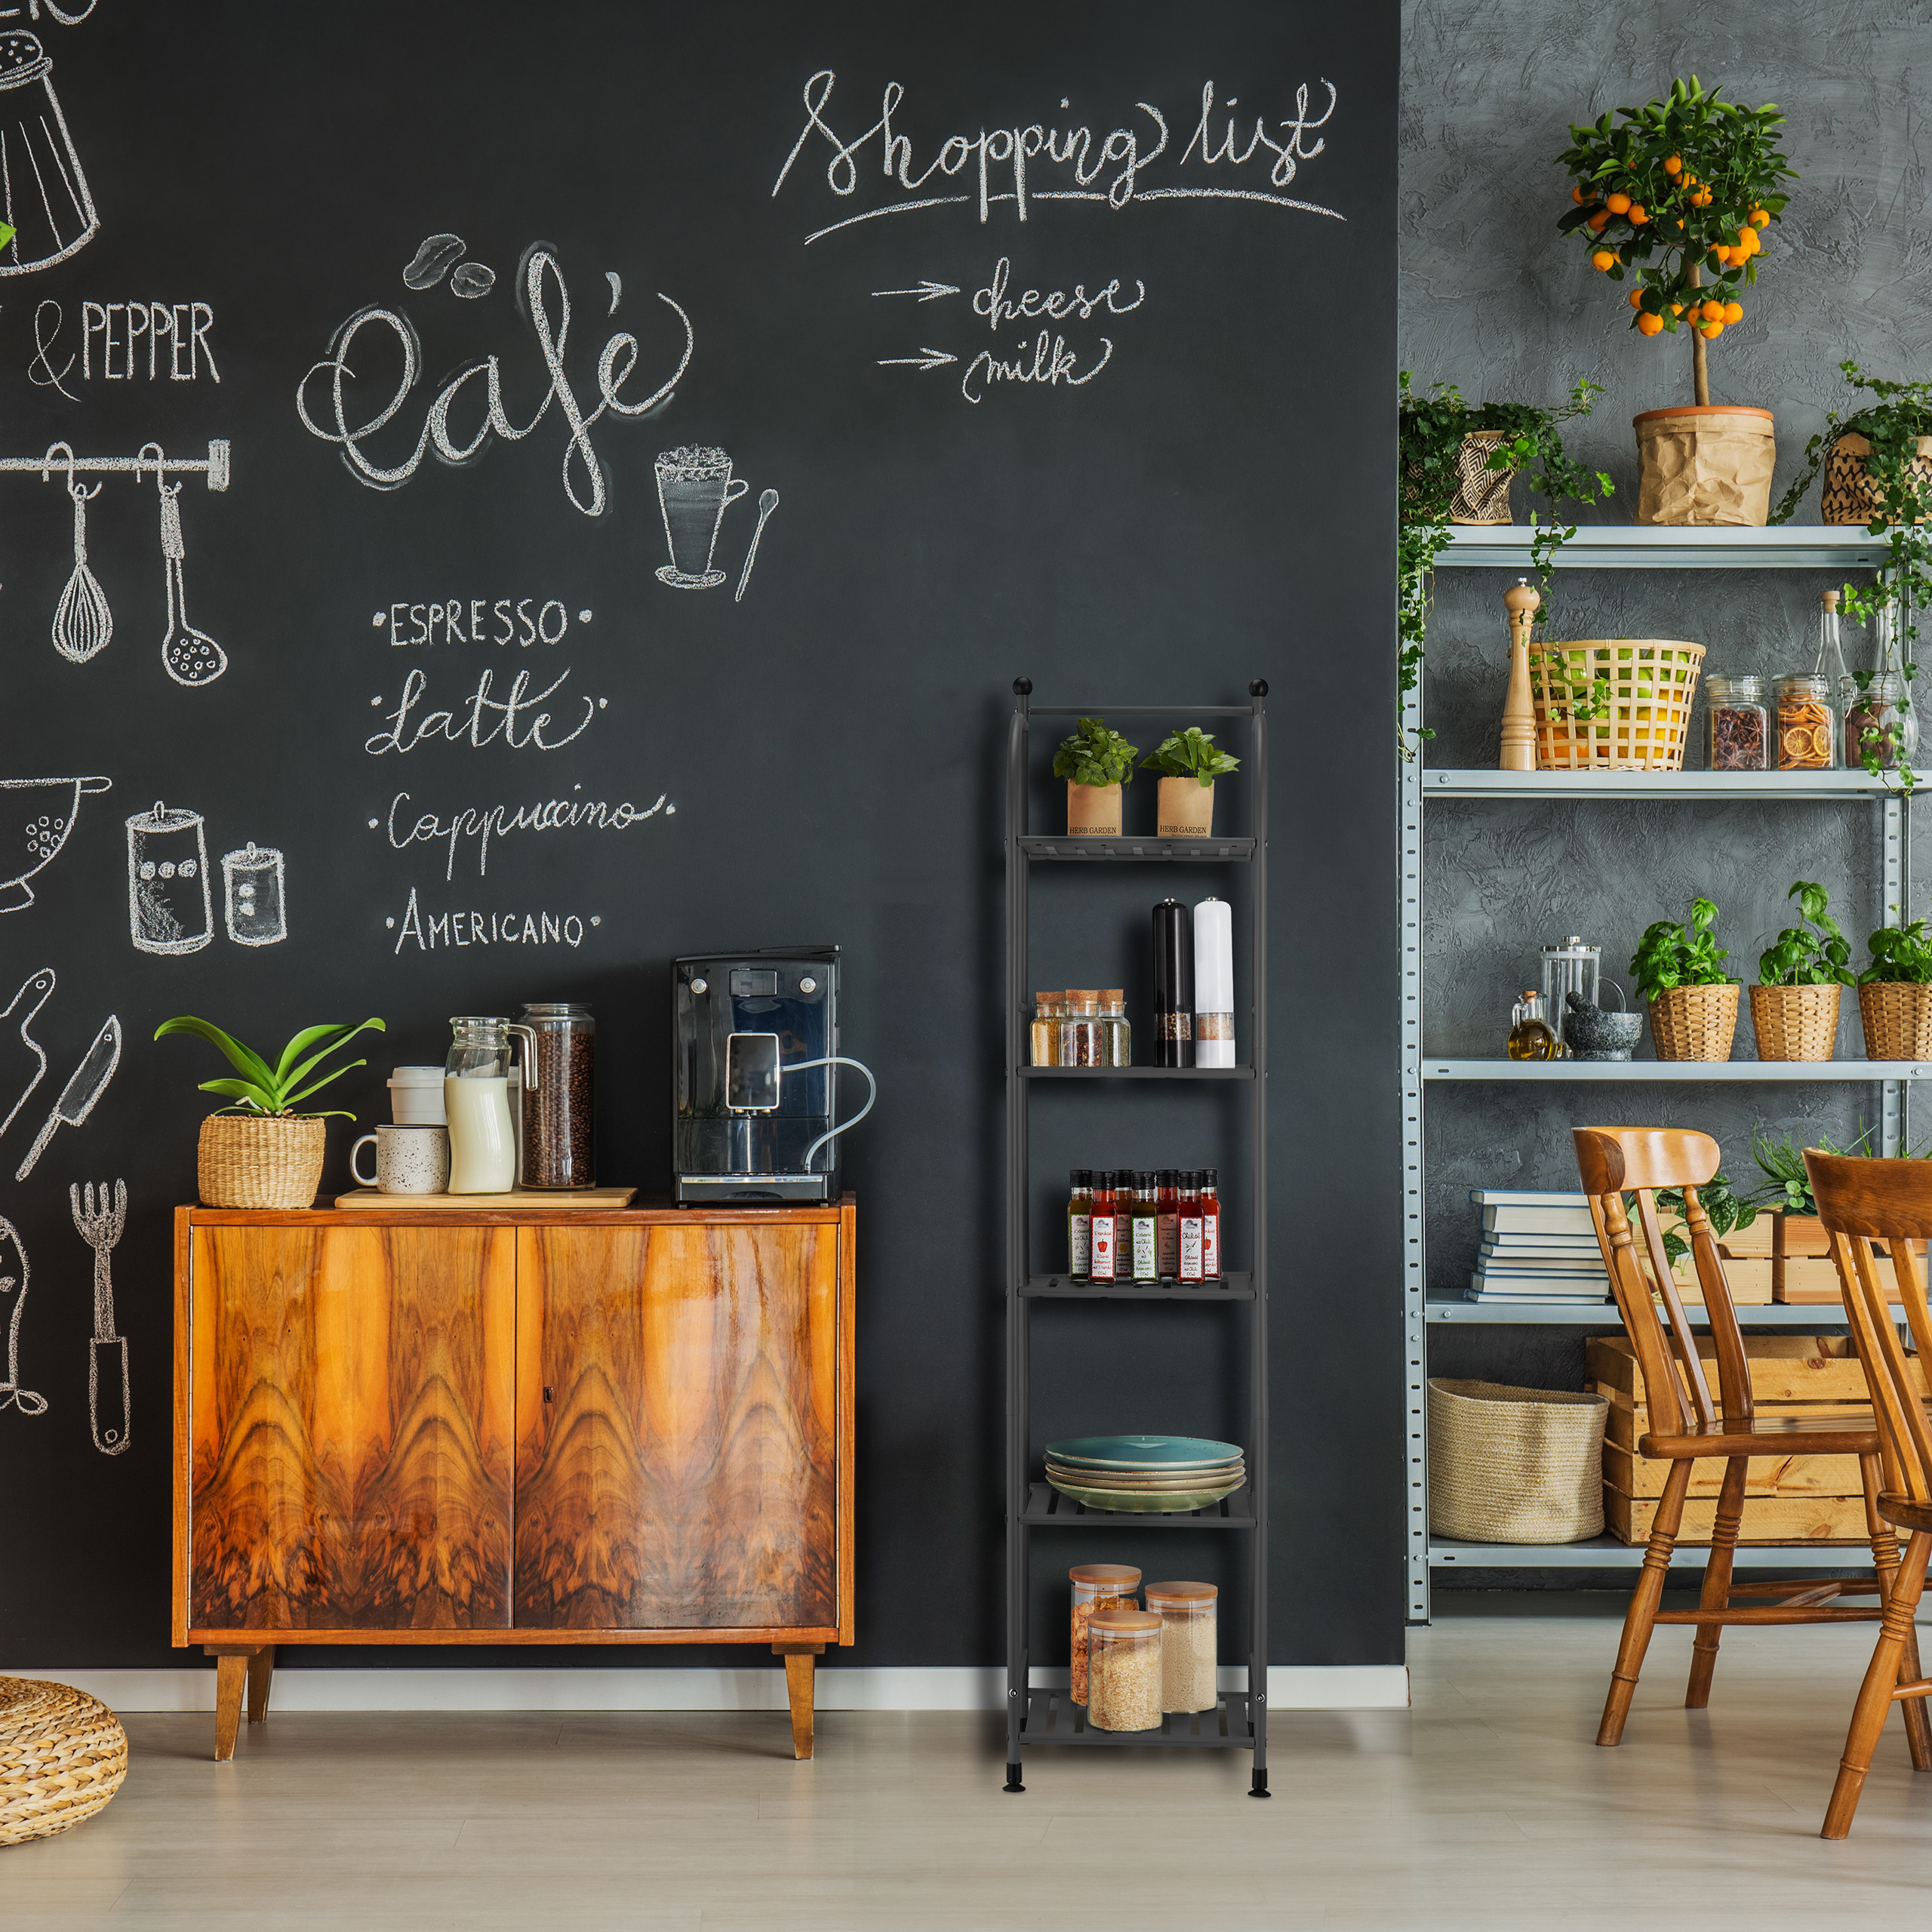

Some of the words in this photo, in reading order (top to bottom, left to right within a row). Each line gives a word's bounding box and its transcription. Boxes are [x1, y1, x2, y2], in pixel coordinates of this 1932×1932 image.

[771, 69, 1168, 223] Shopping
[1180, 77, 1338, 187] list
[972, 257, 1146, 331] cheese
[28, 300, 82, 402] &
[82, 300, 220, 383] PEPPER
[961, 328, 1113, 404] milk
[390, 598, 568, 648] ESPRESSO
[365, 666, 595, 755] Latte
[1159, 825, 1179, 833] HERB
[1179, 826, 1207, 834] GARDEN
[394, 886, 584, 955] AMERICANO
